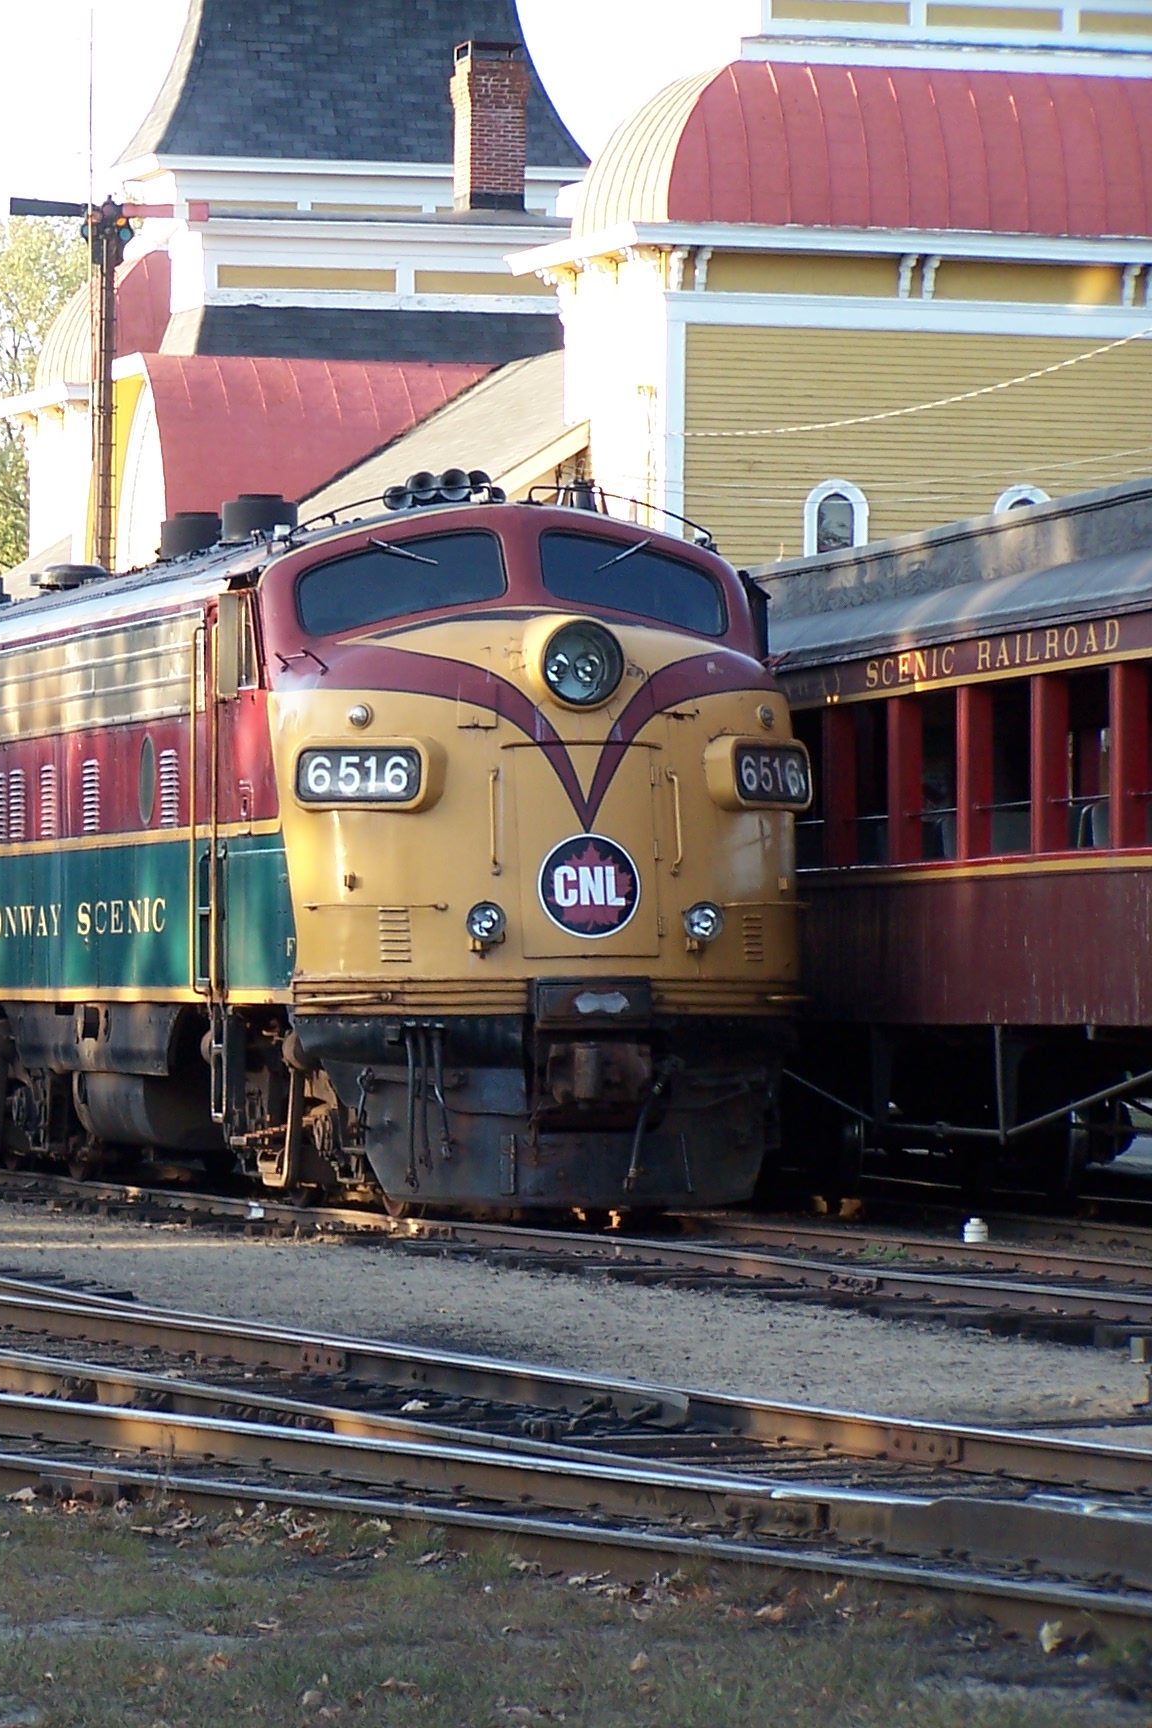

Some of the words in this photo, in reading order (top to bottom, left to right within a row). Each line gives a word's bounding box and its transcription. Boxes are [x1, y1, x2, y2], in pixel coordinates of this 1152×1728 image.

[865, 646, 955, 688] SCENIC
[976, 618, 1120, 671] RAILROAD
[307, 755, 408, 794] 6516
[741, 755, 801, 797] 6516
[553, 865, 626, 907] CNL
[76, 897, 166, 936] SCENIC
